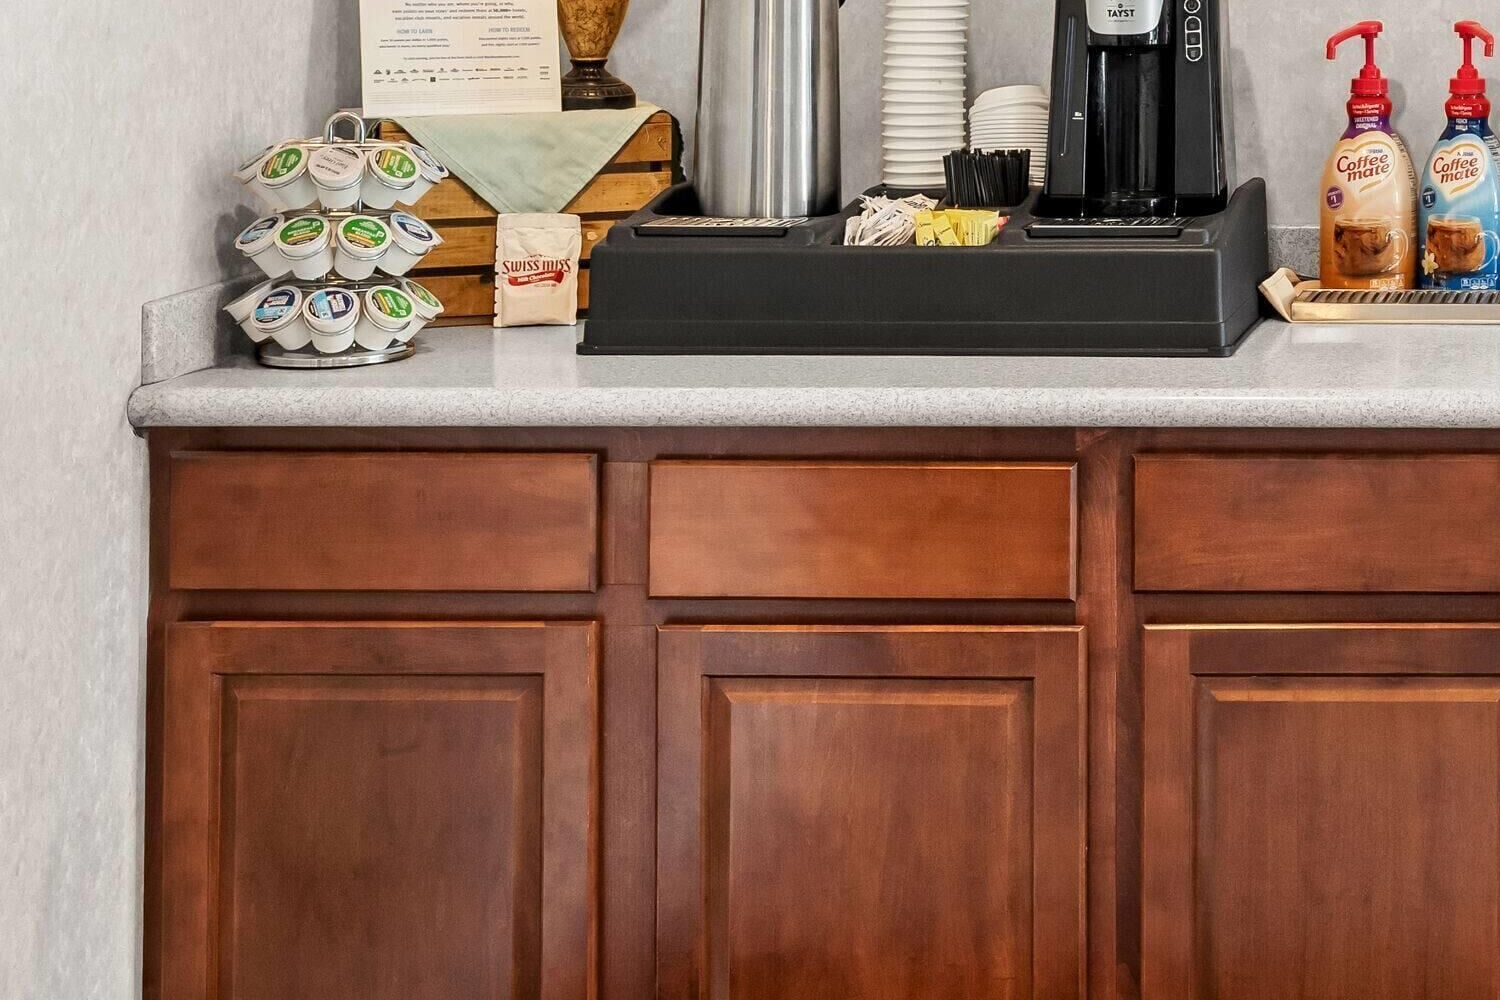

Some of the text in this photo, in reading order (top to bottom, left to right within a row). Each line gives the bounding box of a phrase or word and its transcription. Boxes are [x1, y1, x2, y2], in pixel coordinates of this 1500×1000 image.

[1107, 9, 1135, 18] TAYST
[1336, 154, 1388, 173] Coffee
[1347, 163, 1390, 182] mate
[1433, 156, 1478, 174] Coffee
[1440, 166, 1479, 184] mate
[502, 258, 571, 274] SWISS MISS
